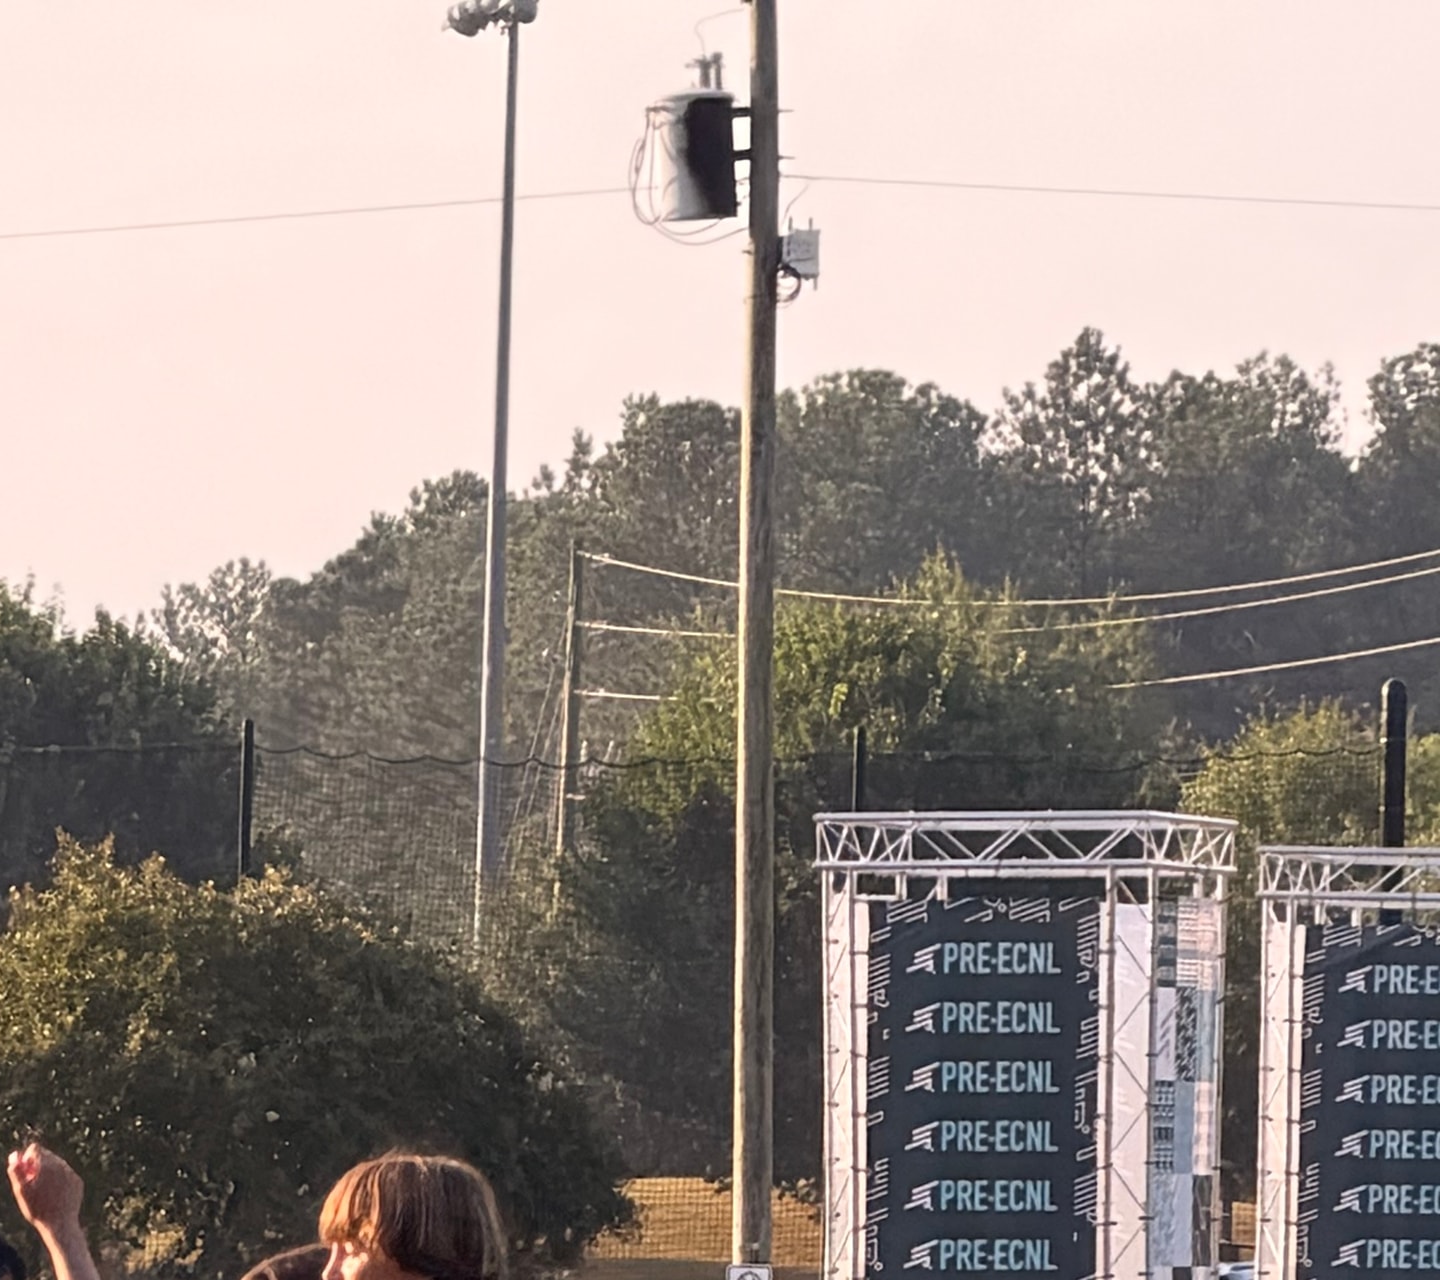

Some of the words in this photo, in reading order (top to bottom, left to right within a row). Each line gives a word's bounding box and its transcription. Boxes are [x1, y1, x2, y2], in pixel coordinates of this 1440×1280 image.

[943, 942, 1061, 974] PRE-ECNL
[942, 1001, 1061, 1033] PRE-ECNL
[1372, 1019, 1440, 1050] PRE-E
[941, 1061, 1060, 1093] PRE-ECNL
[1370, 1074, 1440, 1105] PRE-E
[940, 1120, 1059, 1152] PRE-ECNL
[940, 1180, 1058, 1212] PRE-ECNL
[939, 1239, 1058, 1271] PRE-ECNL
